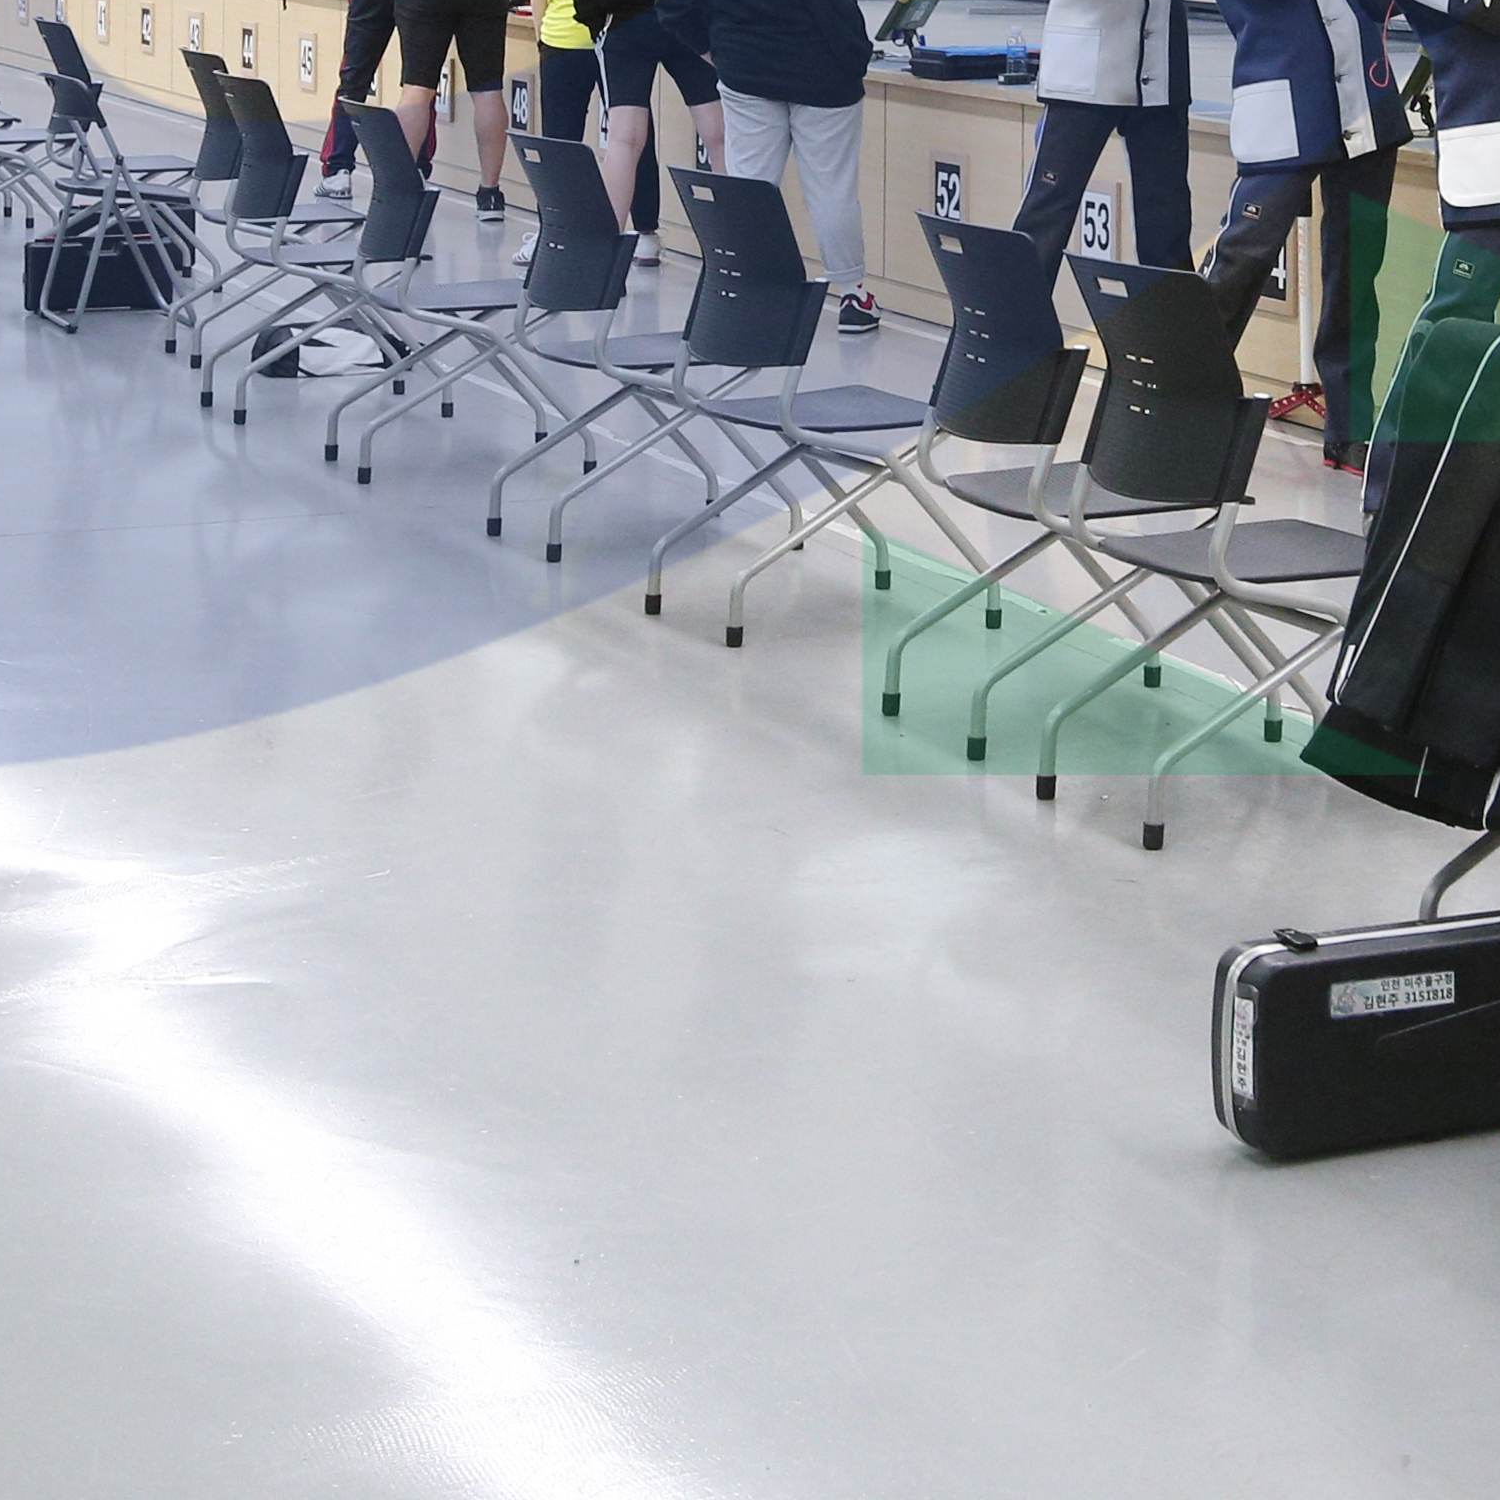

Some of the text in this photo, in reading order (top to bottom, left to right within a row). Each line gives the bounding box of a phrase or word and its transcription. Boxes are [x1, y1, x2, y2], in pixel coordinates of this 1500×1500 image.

[243, 33, 254, 65] 44
[301, 46, 313, 76] 45
[512, 86, 528, 124] 48
[936, 171, 961, 219] 52
[1083, 200, 1110, 251] 53
[1404, 987, 1453, 1004] 3151818
